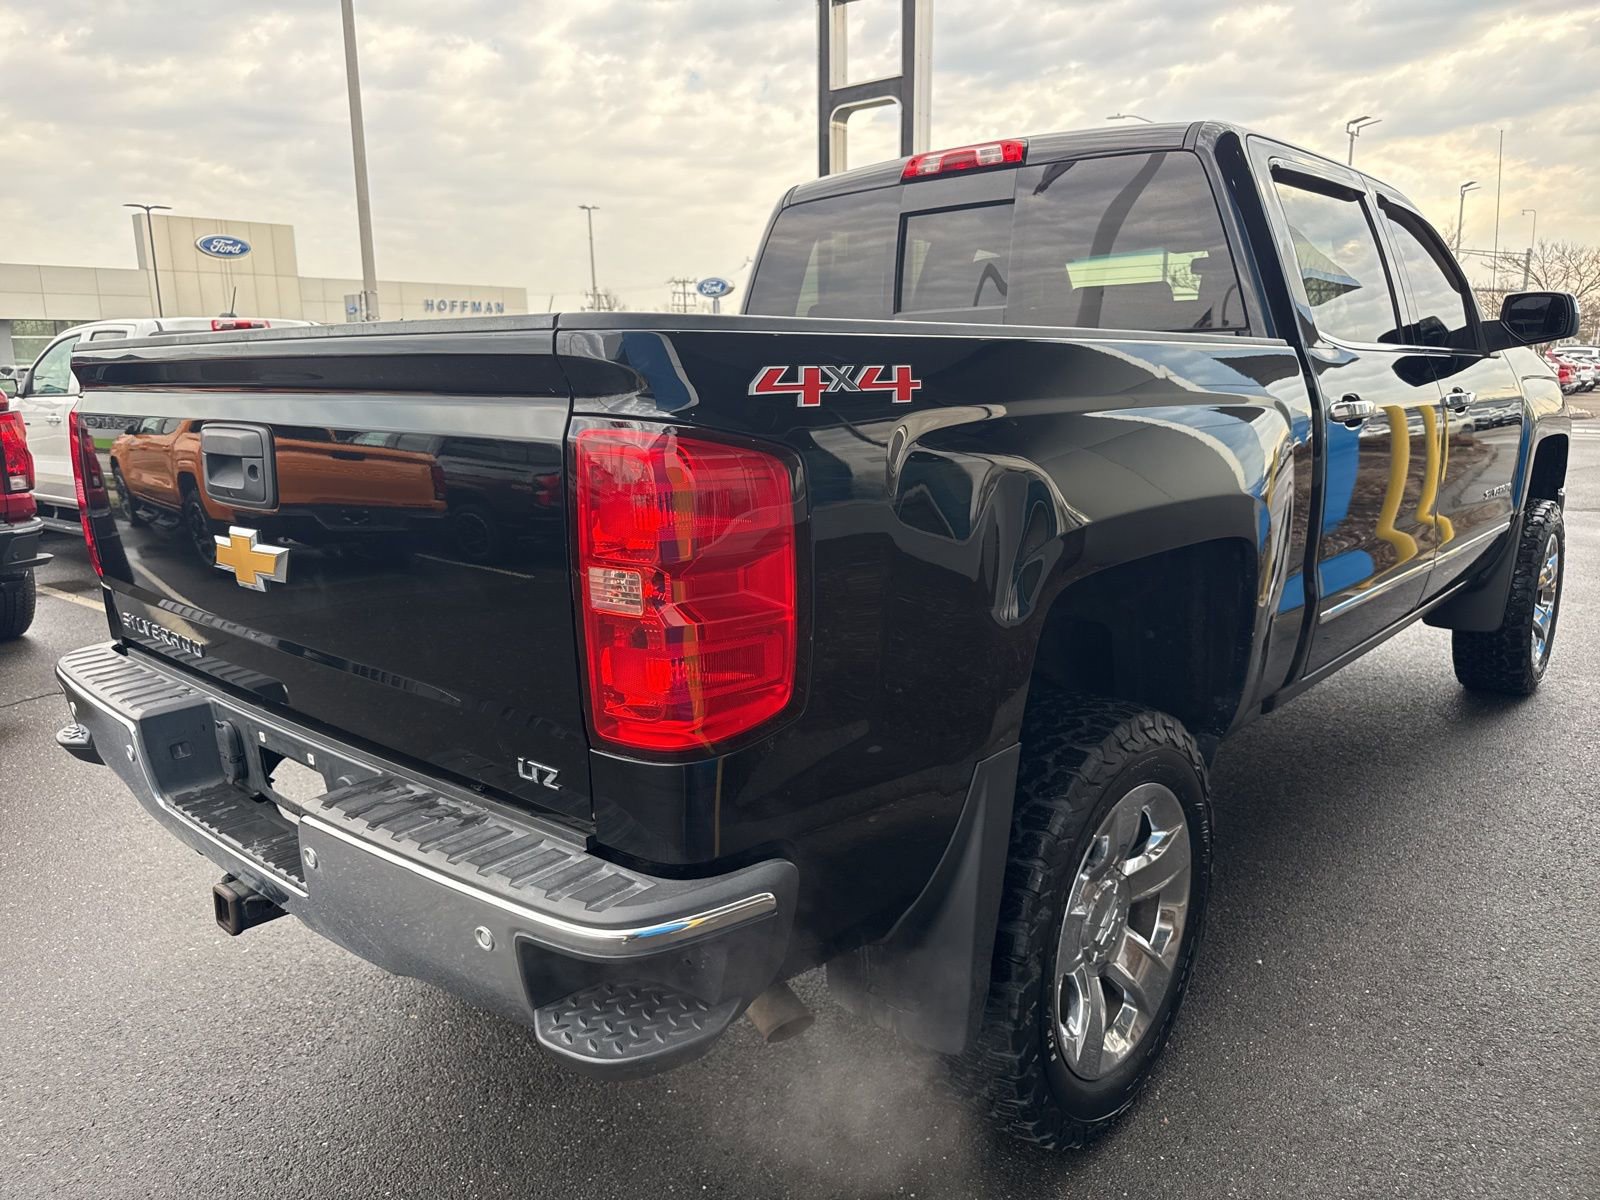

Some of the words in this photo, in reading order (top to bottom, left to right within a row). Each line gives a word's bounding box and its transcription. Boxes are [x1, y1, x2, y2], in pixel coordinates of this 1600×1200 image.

[210, 238, 242, 254] Ford
[703, 281, 723, 294] Ford
[424, 299, 504, 314] HOFFMAN
[517, 756, 562, 791] LTZ
